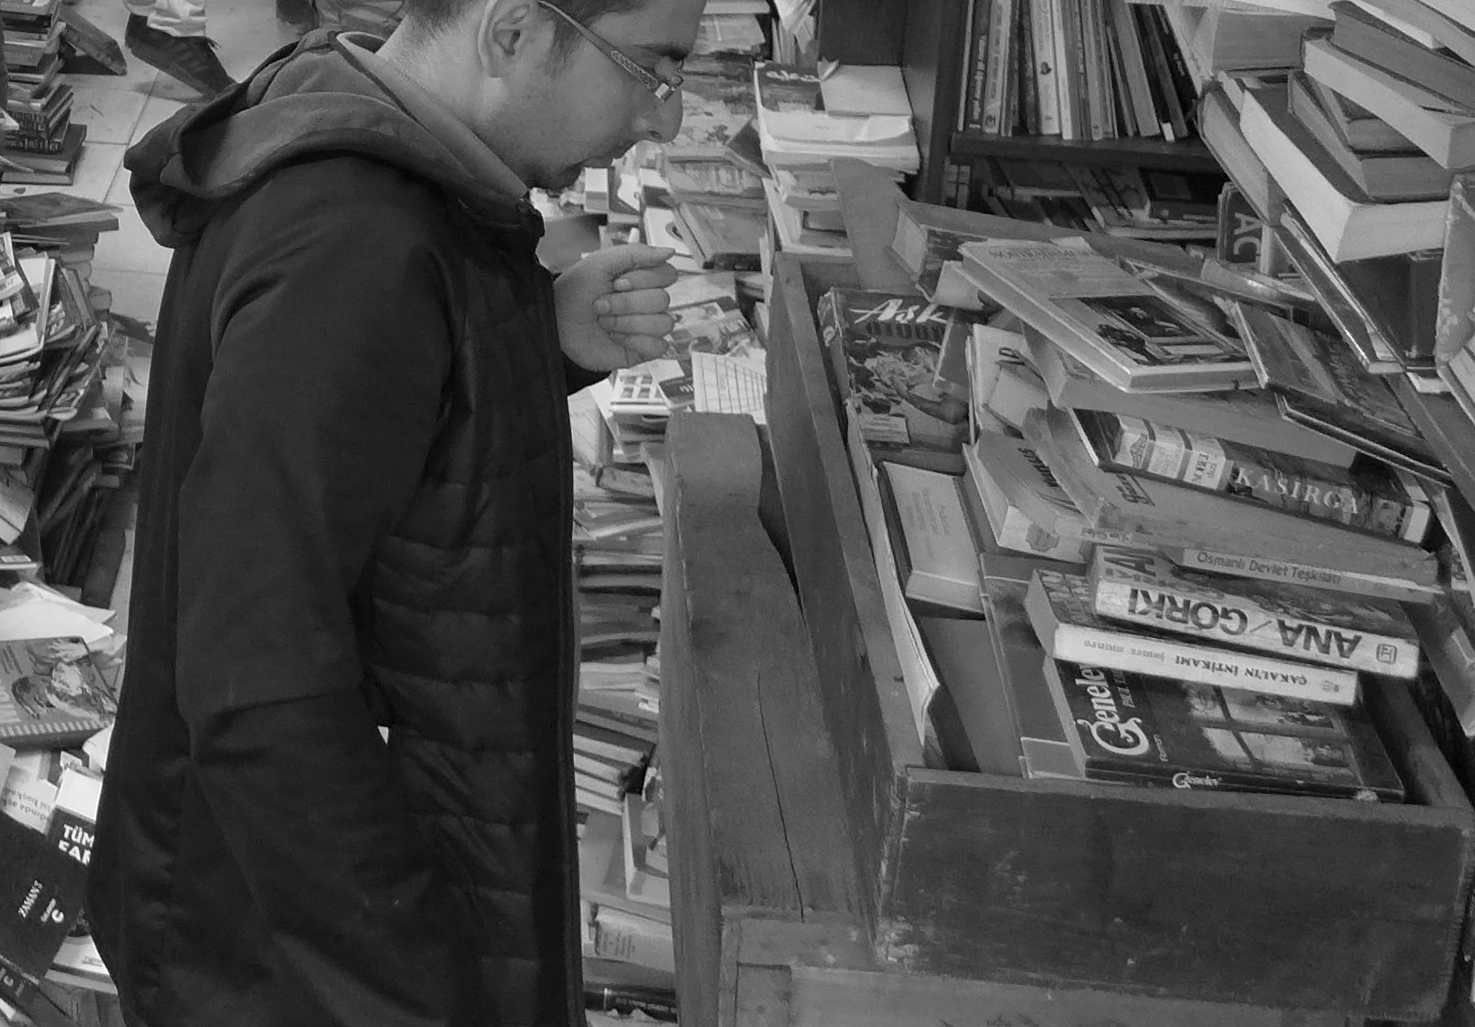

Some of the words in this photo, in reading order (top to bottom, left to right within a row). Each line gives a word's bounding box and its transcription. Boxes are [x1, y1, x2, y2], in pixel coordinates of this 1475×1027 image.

[1234, 466, 1358, 514] KASIRGA
[1196, 552, 1245, 570] Osmanlı
[1248, 558, 1288, 575] Devlet
[1290, 565, 1341, 585] Teşkilatı
[1275, 618, 1362, 659] ANA
[1175, 654, 1239, 677] İNTİKAMI
[1074, 665, 1150, 756] Genele
